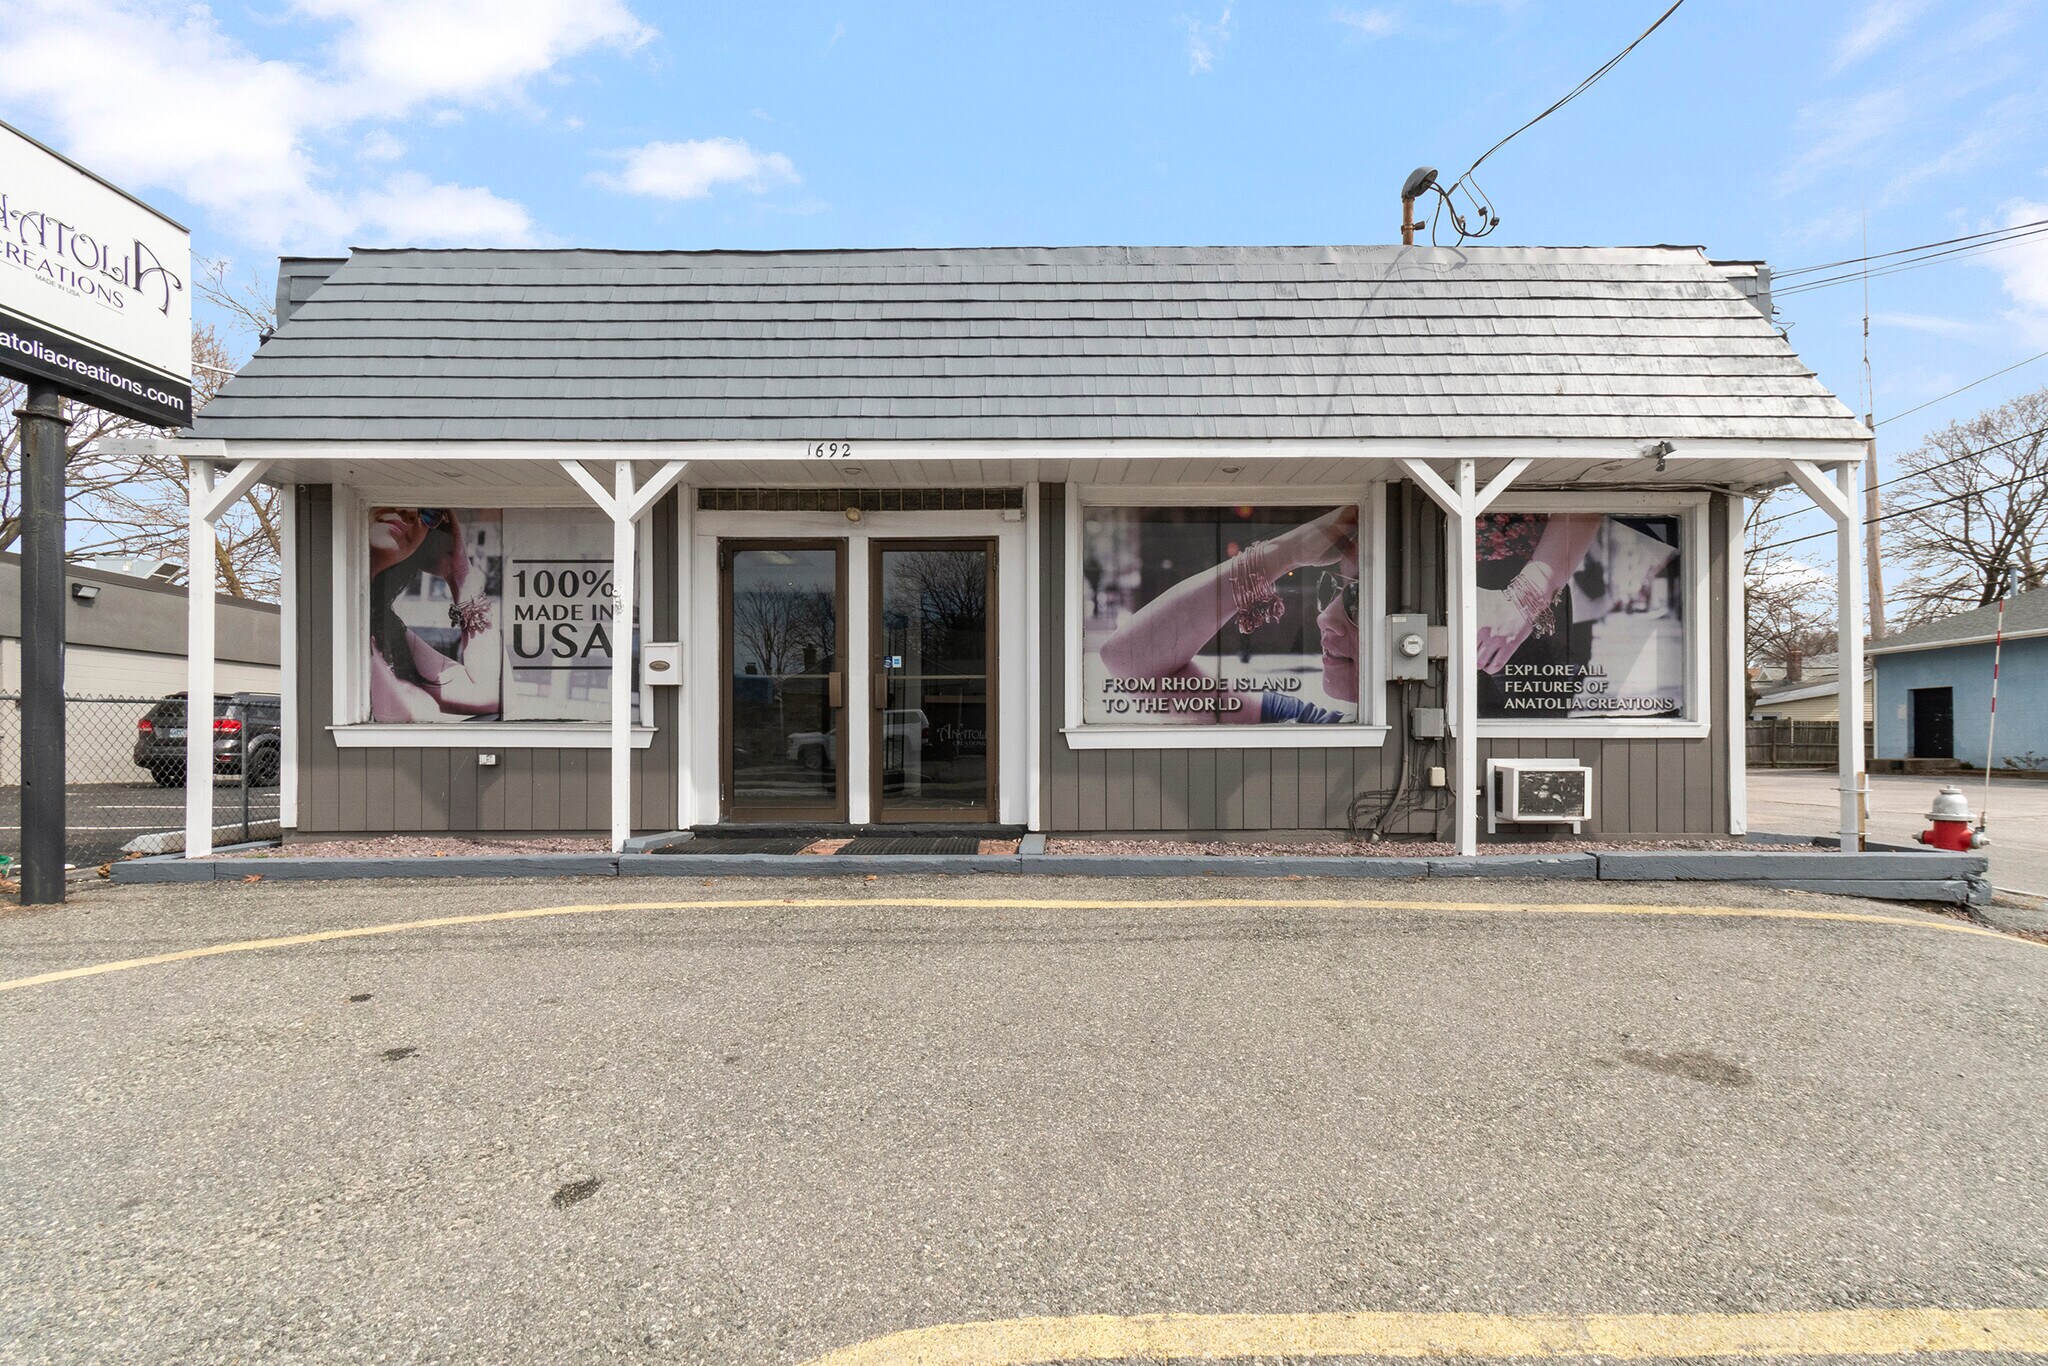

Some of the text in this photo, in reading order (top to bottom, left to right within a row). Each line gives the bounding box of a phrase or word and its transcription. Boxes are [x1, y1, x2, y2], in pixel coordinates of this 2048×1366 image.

[0, 239, 124, 309] REATIONS
[34, 273, 56, 288] MADE
[65, 285, 81, 298] USA
[807, 442, 851, 458] 1692
[512, 570, 614, 598] 100%
[515, 604, 614, 621] MADE IN
[513, 623, 613, 659] USA
[1504, 664, 1607, 677] EXPLORE ALL
[1103, 676, 1301, 693] FROM RHODE ISLAND
[1504, 681, 1609, 693] FEATURES OF
[1103, 697, 1242, 712] TO THE WORLD
[1504, 697, 1674, 709] ANATOLIA CREATIONS
